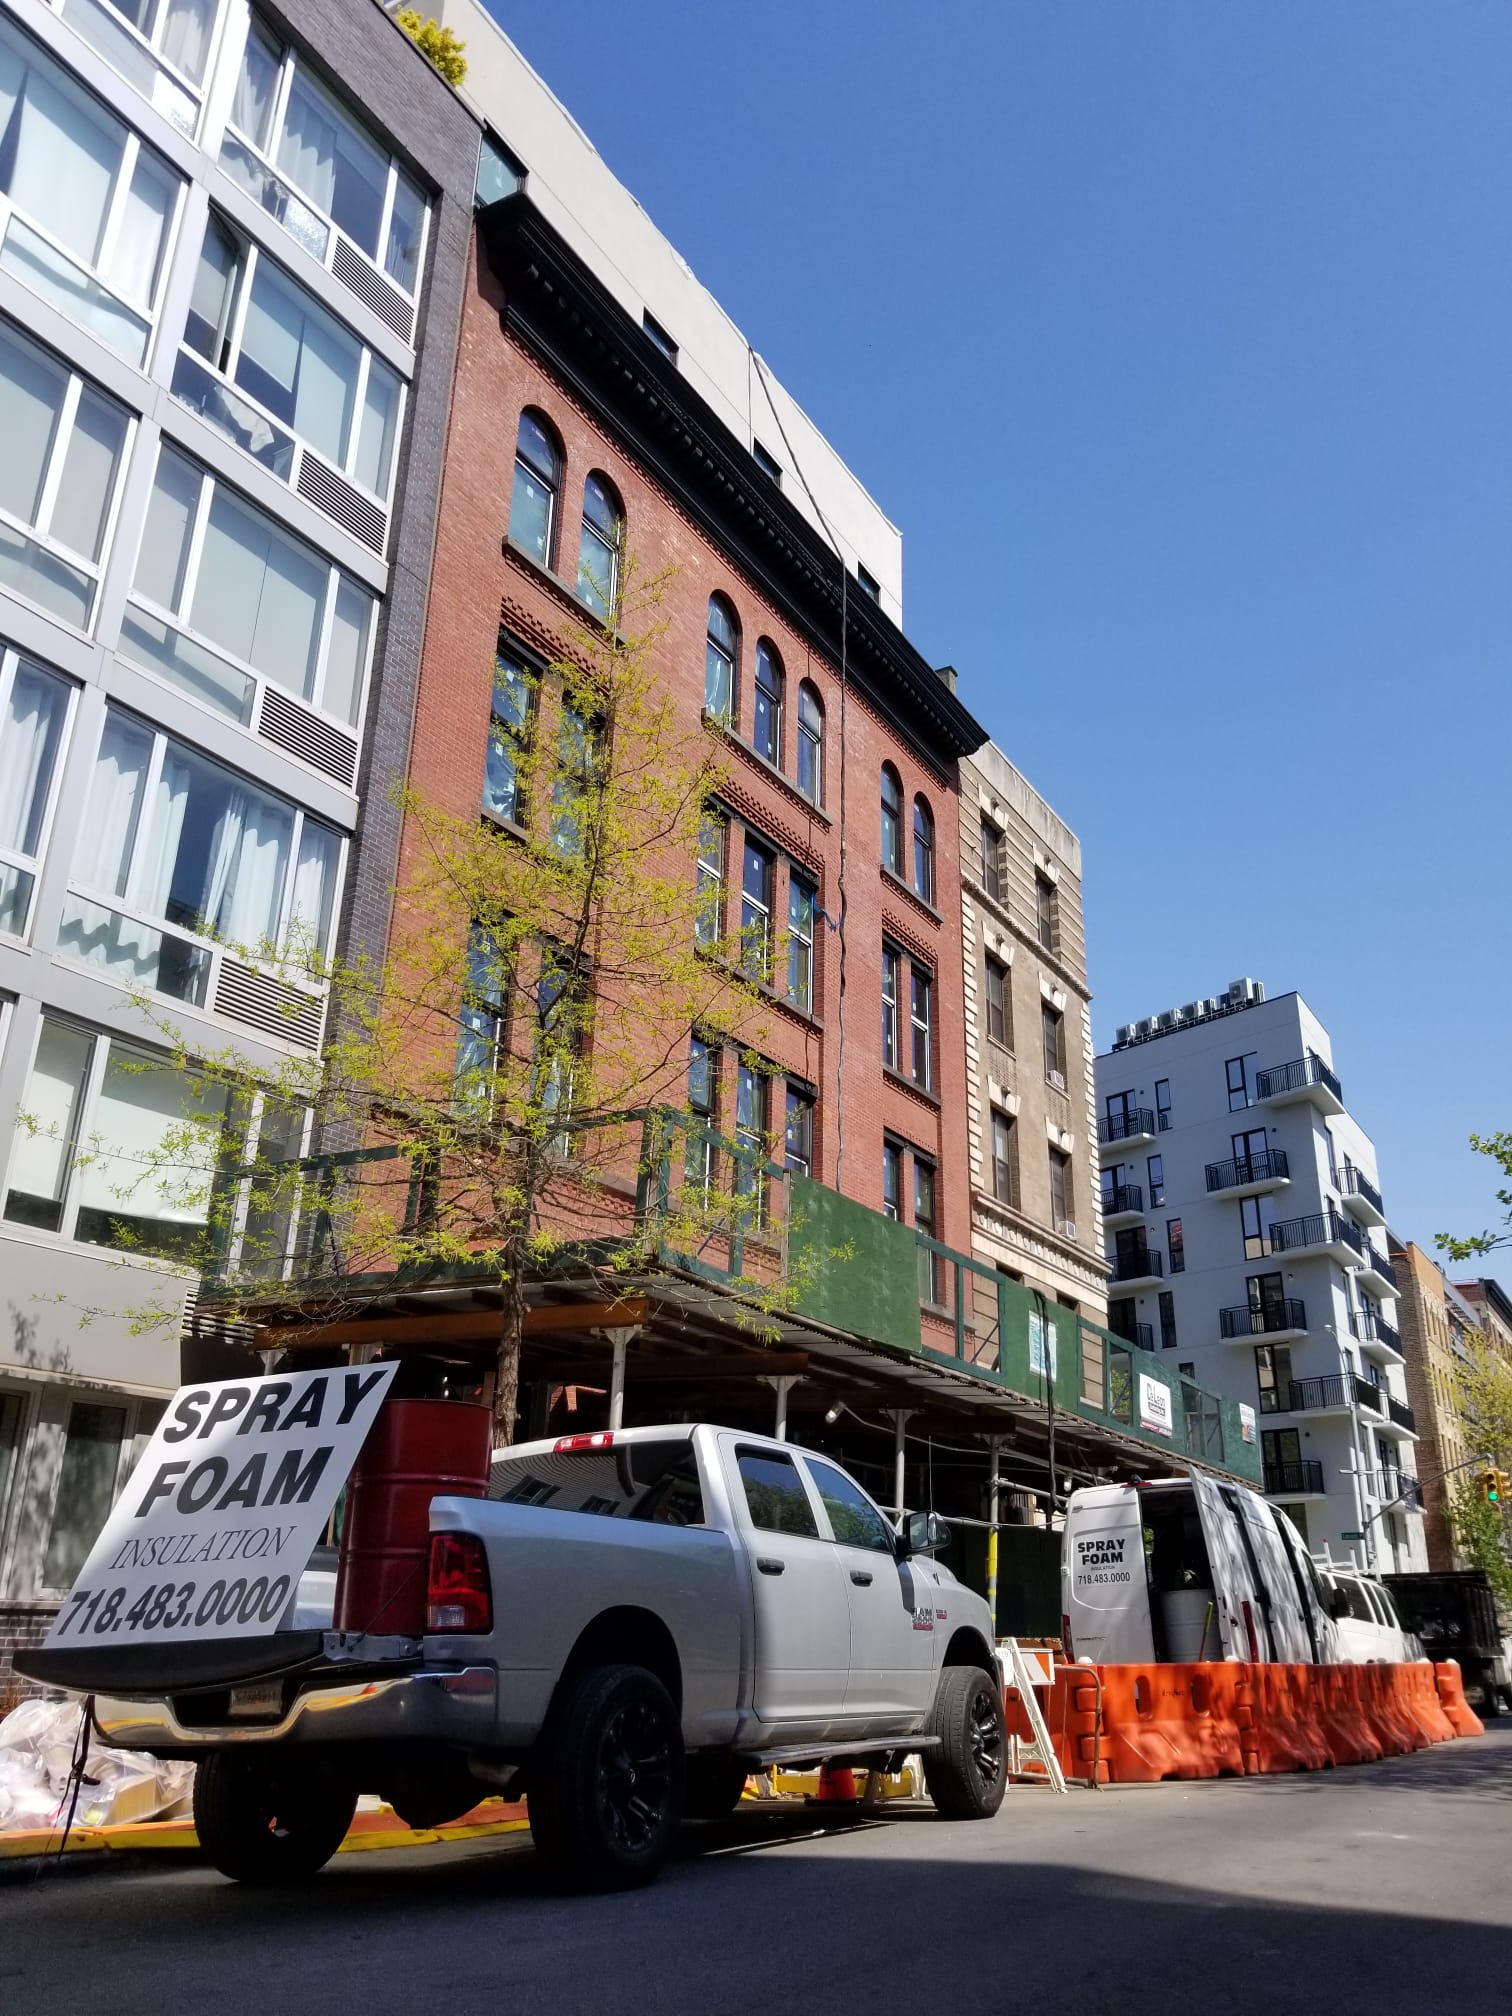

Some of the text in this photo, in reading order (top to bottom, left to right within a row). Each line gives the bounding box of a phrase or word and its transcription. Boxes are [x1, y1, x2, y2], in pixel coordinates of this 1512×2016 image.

[162, 1369, 389, 1444] SPRAY
[134, 1445, 336, 1519] FOAM
[107, 1525, 297, 1570] INSULATION
[1077, 1539, 1125, 1553] SPRAY
[1082, 1552, 1124, 1565] FOAM
[1078, 1572, 1131, 1584] 718.483.0000
[57, 1574, 291, 1636] 718.483.0000
